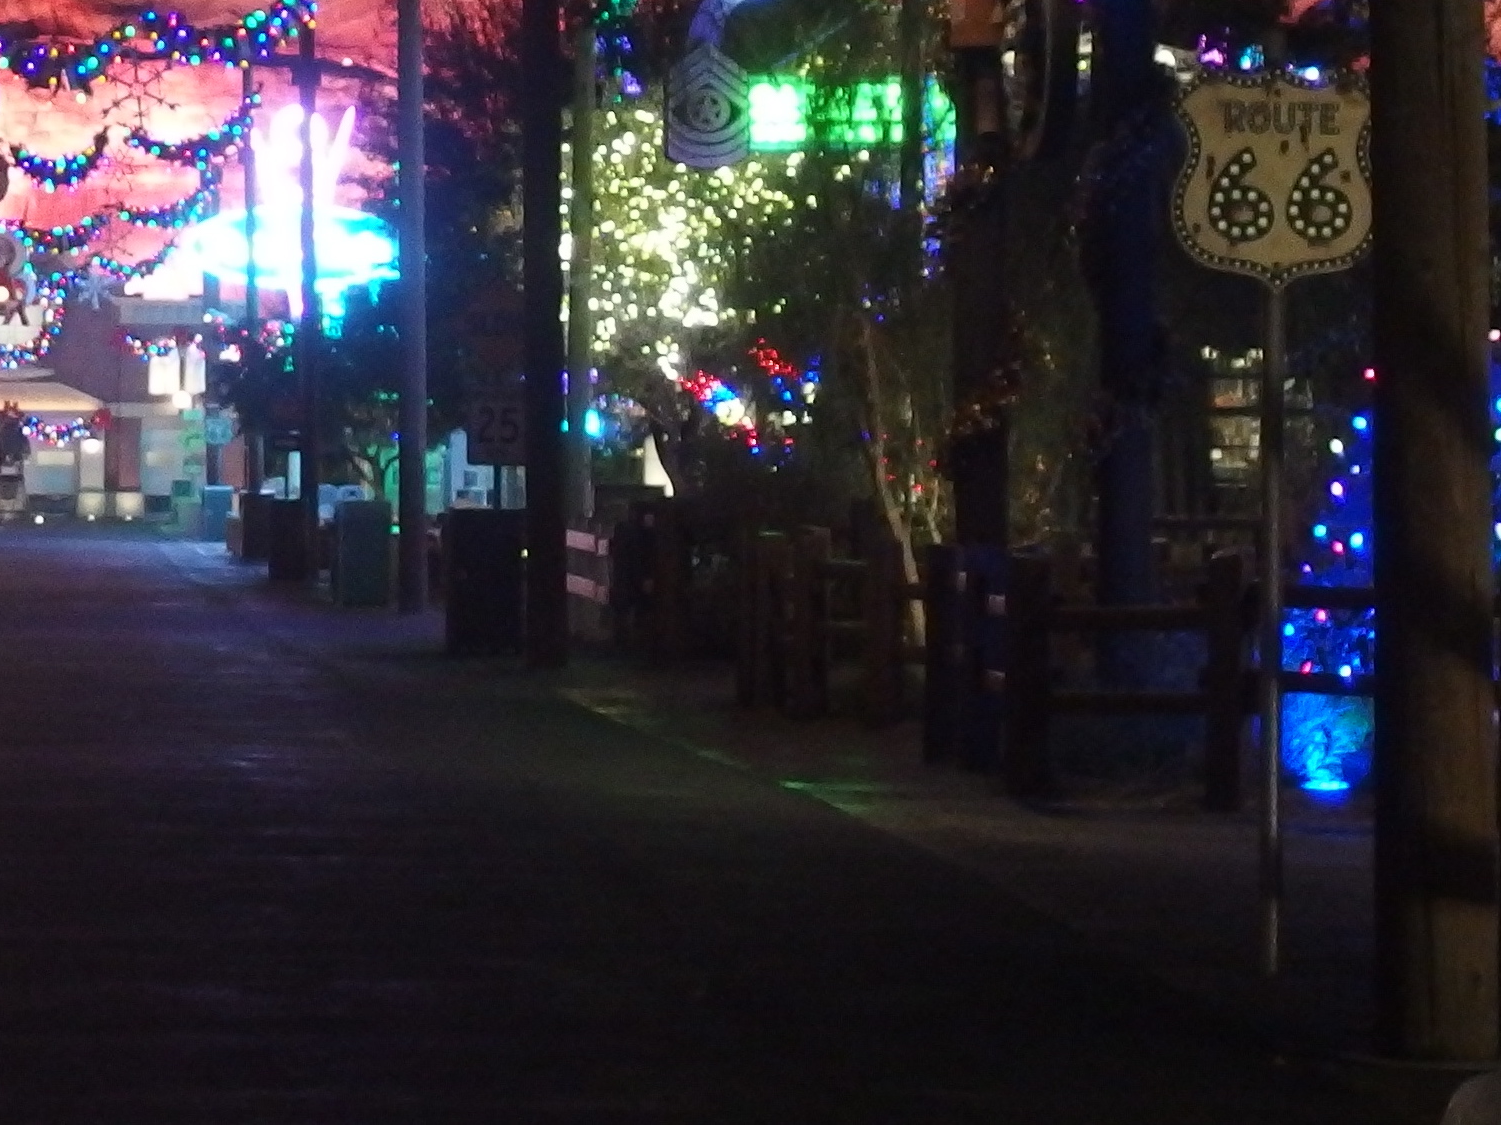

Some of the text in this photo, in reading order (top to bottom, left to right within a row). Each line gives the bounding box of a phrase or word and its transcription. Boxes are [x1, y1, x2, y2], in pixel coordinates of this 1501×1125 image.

[1223, 101, 1341, 136] ROUTE
[1208, 146, 1353, 242] 66
[478, 406, 519, 444] 25
